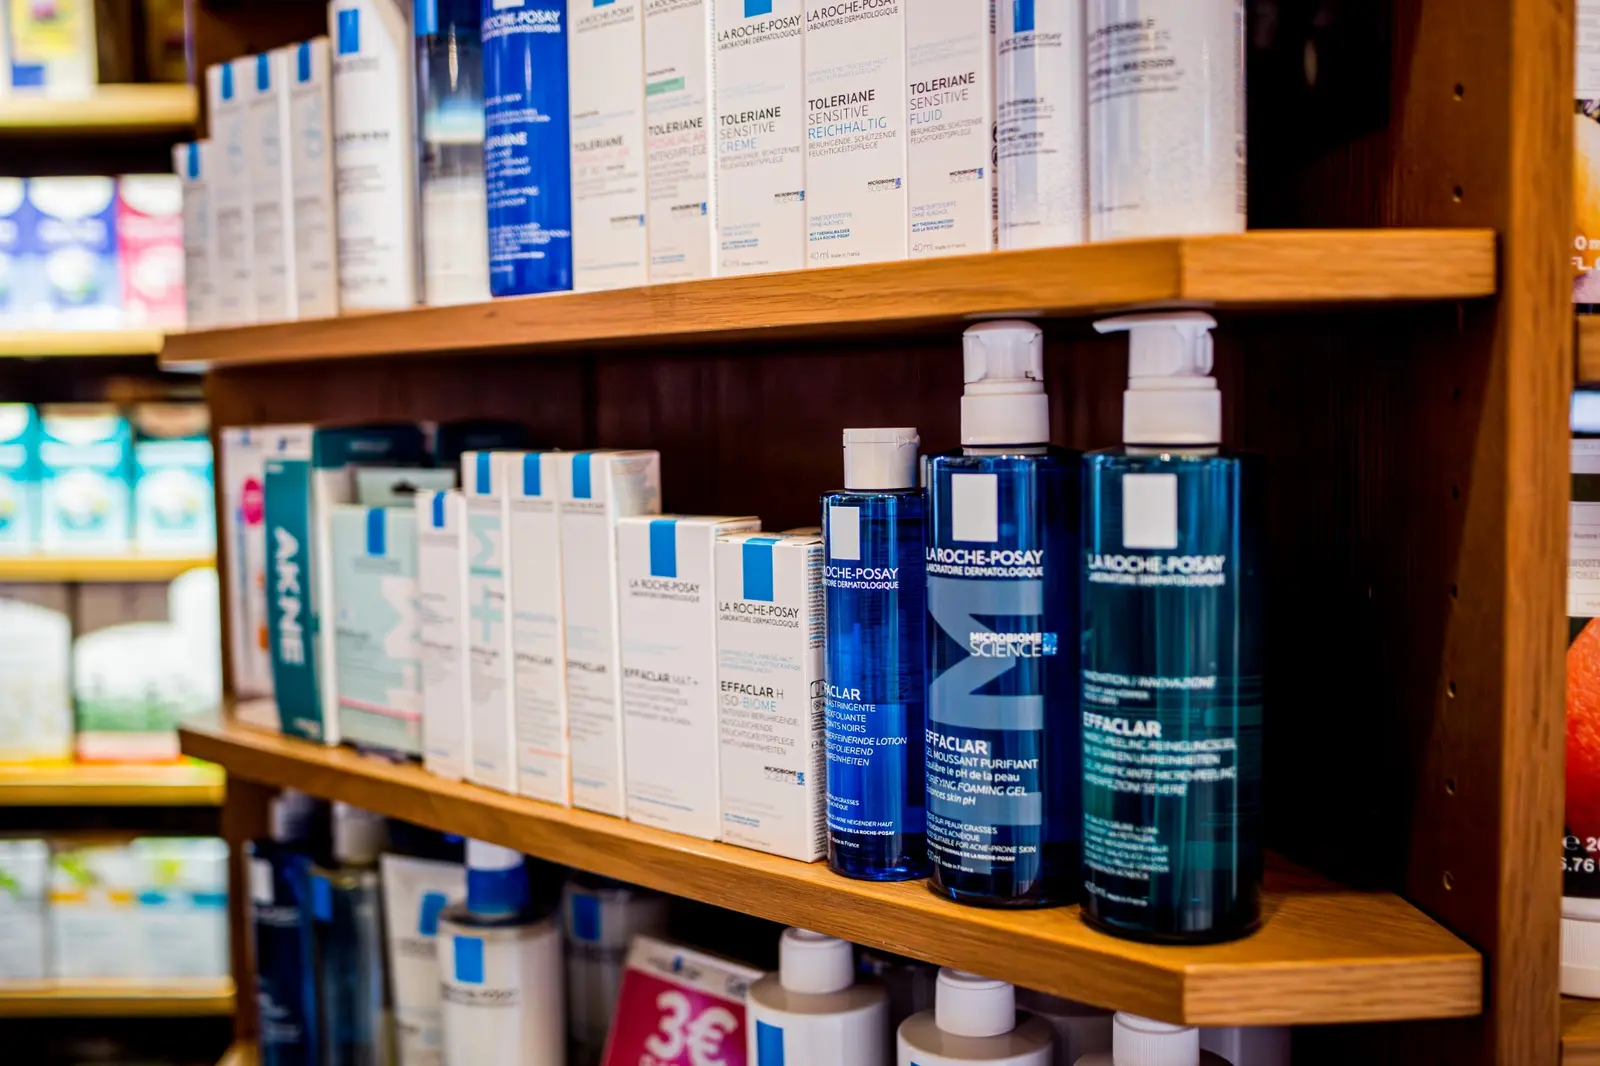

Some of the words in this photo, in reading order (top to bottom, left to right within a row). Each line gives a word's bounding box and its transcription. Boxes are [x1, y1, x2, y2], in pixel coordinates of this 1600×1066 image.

[806, 10, 820, 22] LA
[806, 18, 843, 31] LABORATOIRE
[844, 6, 898, 24] DERMATOLOGIQUE
[717, 30, 730, 42] LA
[731, 14, 802, 39] ROCHE-POSAY
[910, 71, 976, 96] TOLERIANE
[808, 89, 876, 111] TOLERIANE
[909, 88, 969, 111] SENSITIVE
[720, 106, 781, 127] TOLERIANE
[808, 104, 869, 126] SENSITIVE
[909, 108, 943, 125] FLUID
[649, 117, 704, 136] TOLERIANE
[719, 121, 776, 140] SENSITIVE
[807, 116, 887, 140] REICHHALTIG
[926, 546, 937, 561] LA
[937, 547, 1044, 566] ROCHE-POSAY
[1103, 554, 1226, 575] ROCHE-POSAY
[926, 562, 963, 576] LABORATOIRE
[964, 566, 1044, 578] DERMATOLOGIQUE
[641, 579, 700, 594] ROCHE-POSAY
[837, 580, 899, 590] DERMATOLOGIQUE
[273, 526, 306, 666] AKNE
[719, 601, 731, 612] LA
[733, 602, 800, 619] ROCHE-POSAY
[753, 617, 799, 629] DERMATOLOGIQUE
[969, 631, 1042, 644] MICROBIOME
[970, 642, 1042, 658] SCIENCE
[624, 667, 671, 684] EFFACLAR
[720, 680, 774, 699] EFFACLAR
[776, 688, 784, 700] H
[721, 693, 777, 713] ISO-BIOME
[841, 723, 867, 734] NOIRS
[1083, 711, 1162, 738] EFFACLAR
[876, 737, 908, 746] LOTION
[926, 728, 988, 756] EFFACLAR
[933, 750, 979, 768] MOUSSANT
[980, 757, 1039, 770] PURIFIANT
[764, 765, 797, 777] MICROBIOME
[946, 765, 955, 776] le
[955, 768, 968, 779] pH
[969, 769, 982, 781] de
[983, 771, 993, 782] la
[994, 772, 1020, 784] peau
[946, 790, 962, 803] skin
[962, 795, 976, 806] pH
[957, 781, 1005, 797] FOAMING
[1006, 785, 1028, 797] GEL
[847, 818, 877, 828] NEIGENDER
[877, 820, 893, 828] HAUT
[944, 819, 963, 831] PEAUX
[963, 822, 998, 836] GRASSES
[955, 839, 969, 851] FOR
[969, 842, 1017, 855] ACNE-PRONE
[1018, 844, 1037, 855] SKIN
[645, 988, 741, 1066] 3€
